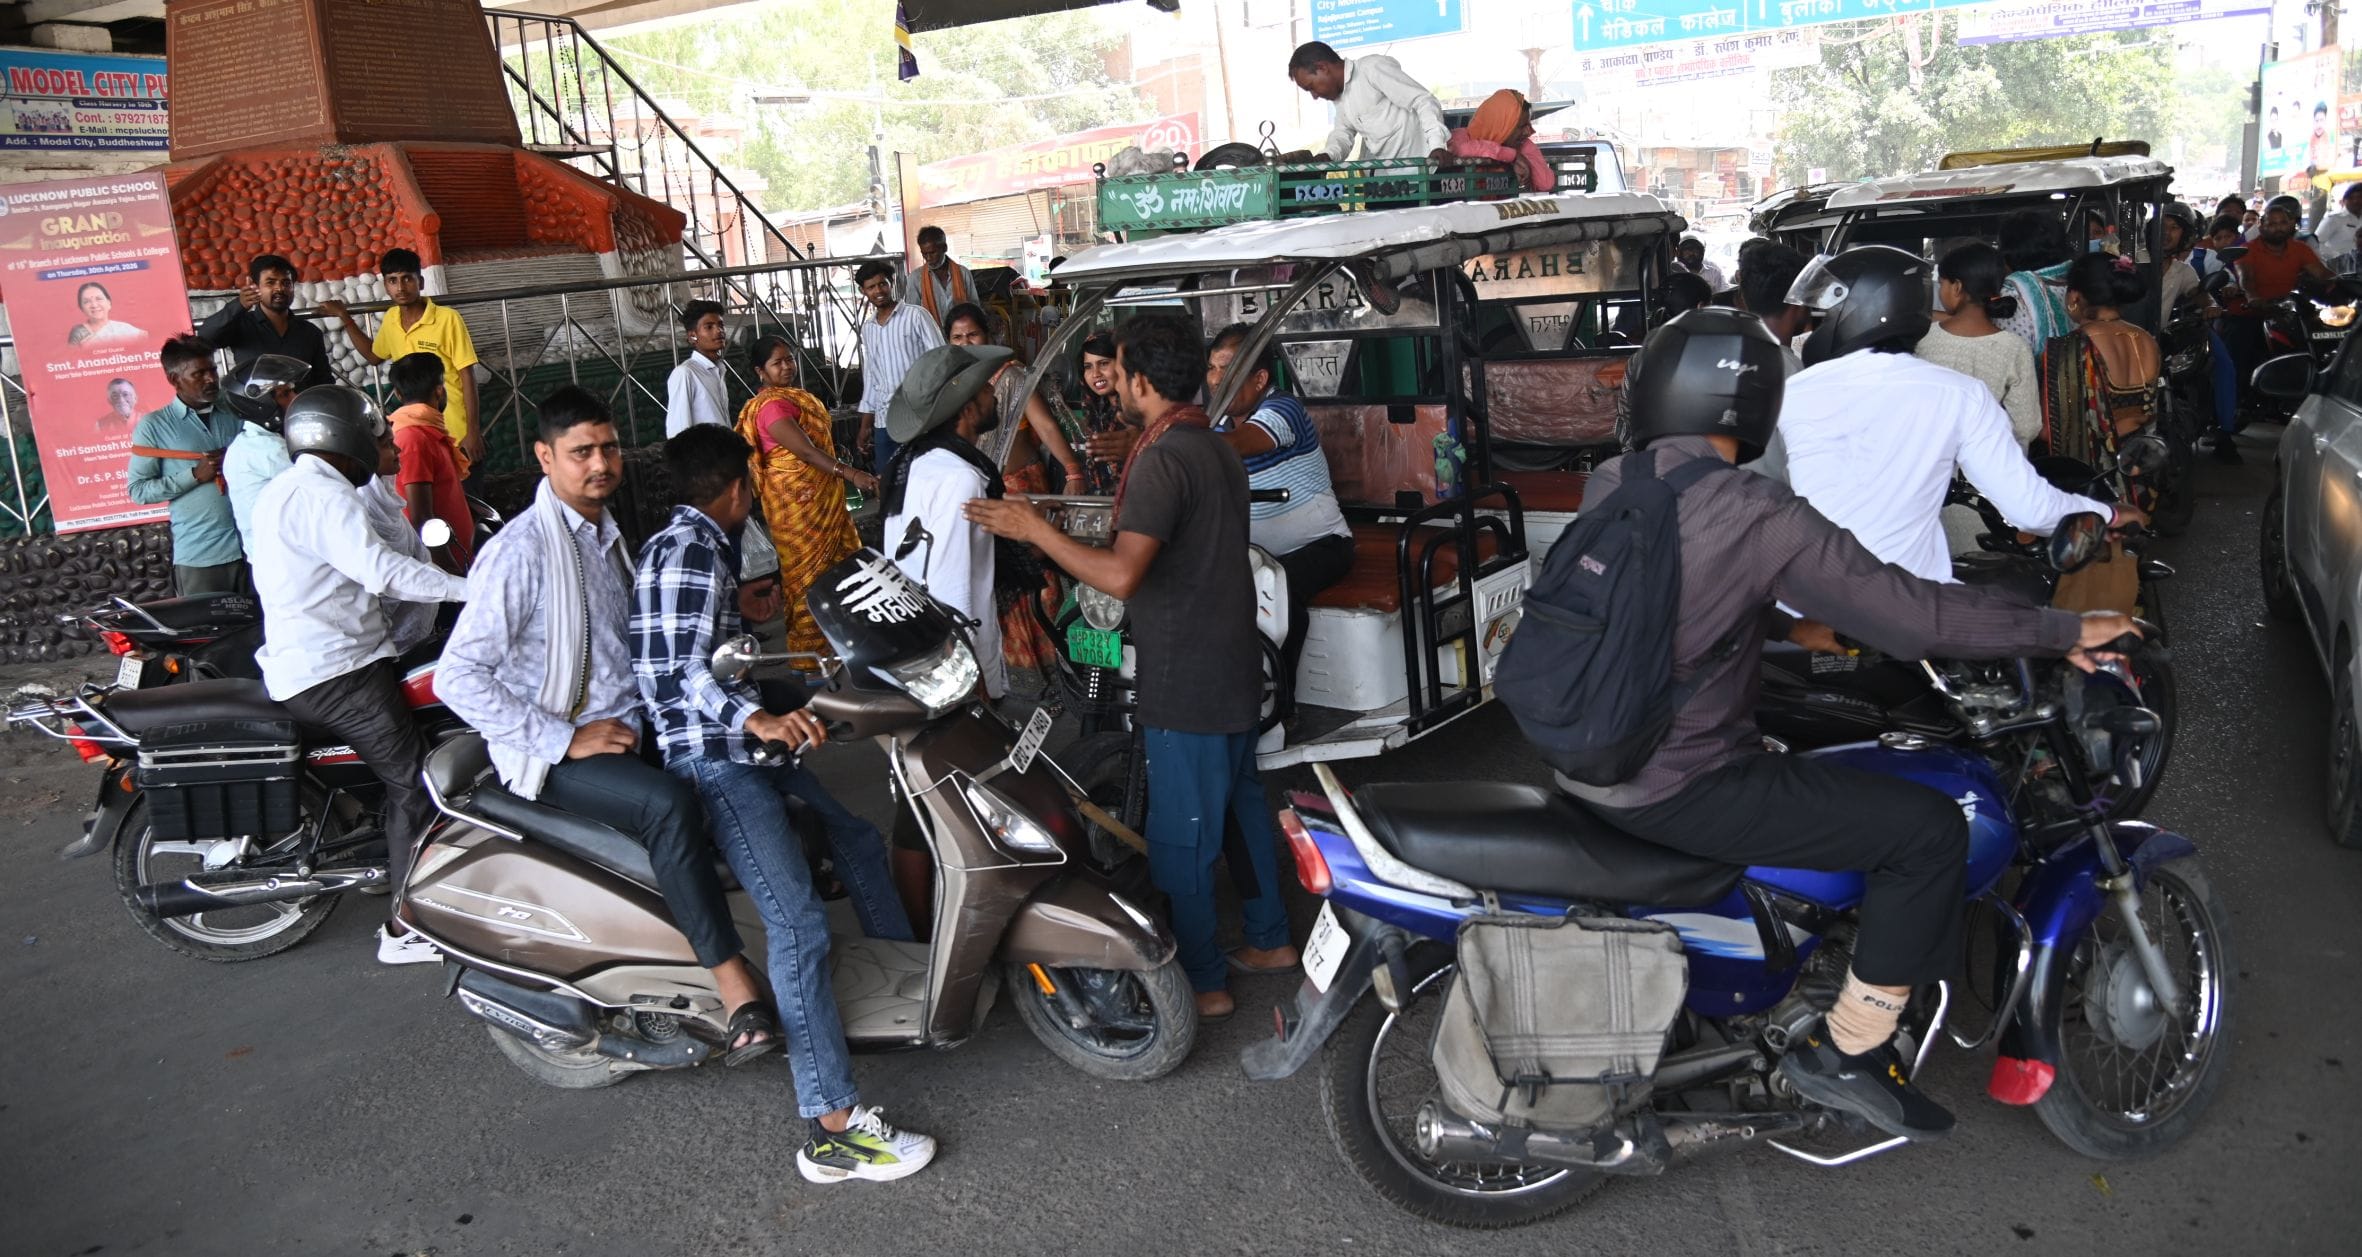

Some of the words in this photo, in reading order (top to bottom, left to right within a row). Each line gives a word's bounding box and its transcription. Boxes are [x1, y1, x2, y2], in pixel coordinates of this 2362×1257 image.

[1601, 18, 1665, 40] मेडिकल
[9, 66, 90, 96] MODEL
[94, 71, 139, 98] CITY
[75, 112, 105, 123] Cont.
[79, 126, 108, 134] E-Mail
[1152, 127, 1180, 147] 20
[5, 137, 31, 145] Add.
[40, 138, 71, 146] Model
[73, 138, 96, 147] City,
[99, 138, 165, 147] Buddheshwar
[9, 190, 68, 204] LUCKNOW
[71, 185, 109, 199] PUBLIC
[111, 181, 158, 195] SCHOOL
[1492, 199, 1560, 220] BHARAT
[40, 211, 124, 236] GRAND
[40, 231, 131, 250] inauguration
[29, 258, 52, 268] Branch
[61, 255, 90, 266] Lucknow
[90, 253, 110, 262] Public
[111, 250, 136, 260] Schools
[137, 249, 142, 257] &
[143, 246, 170, 257] Colleges
[46, 361, 75, 373] Smt.
[77, 352, 143, 369] Anandiben
[56, 447, 77, 458] Shri
[78, 441, 120, 455] Santosh
[77, 475, 92, 485] Dr.
[94, 474, 104, 483] S.
[105, 472, 115, 481] P.
